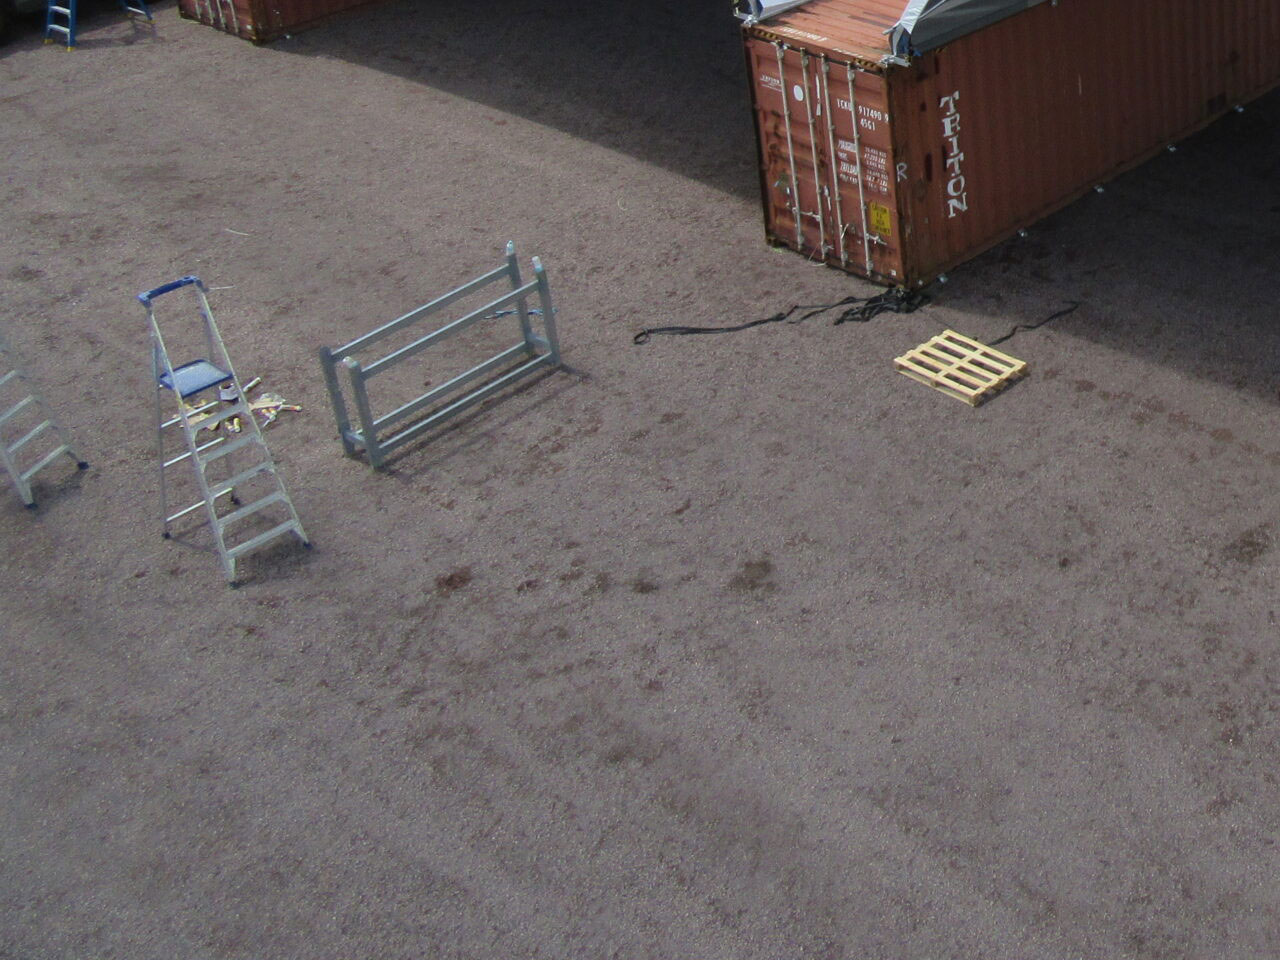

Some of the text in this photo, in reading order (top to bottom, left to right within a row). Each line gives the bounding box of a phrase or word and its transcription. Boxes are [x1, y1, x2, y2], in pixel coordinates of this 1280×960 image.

[859, 105, 881, 121] 917490
[940, 90, 968, 218] TRITON
[896, 162, 907, 182] R
